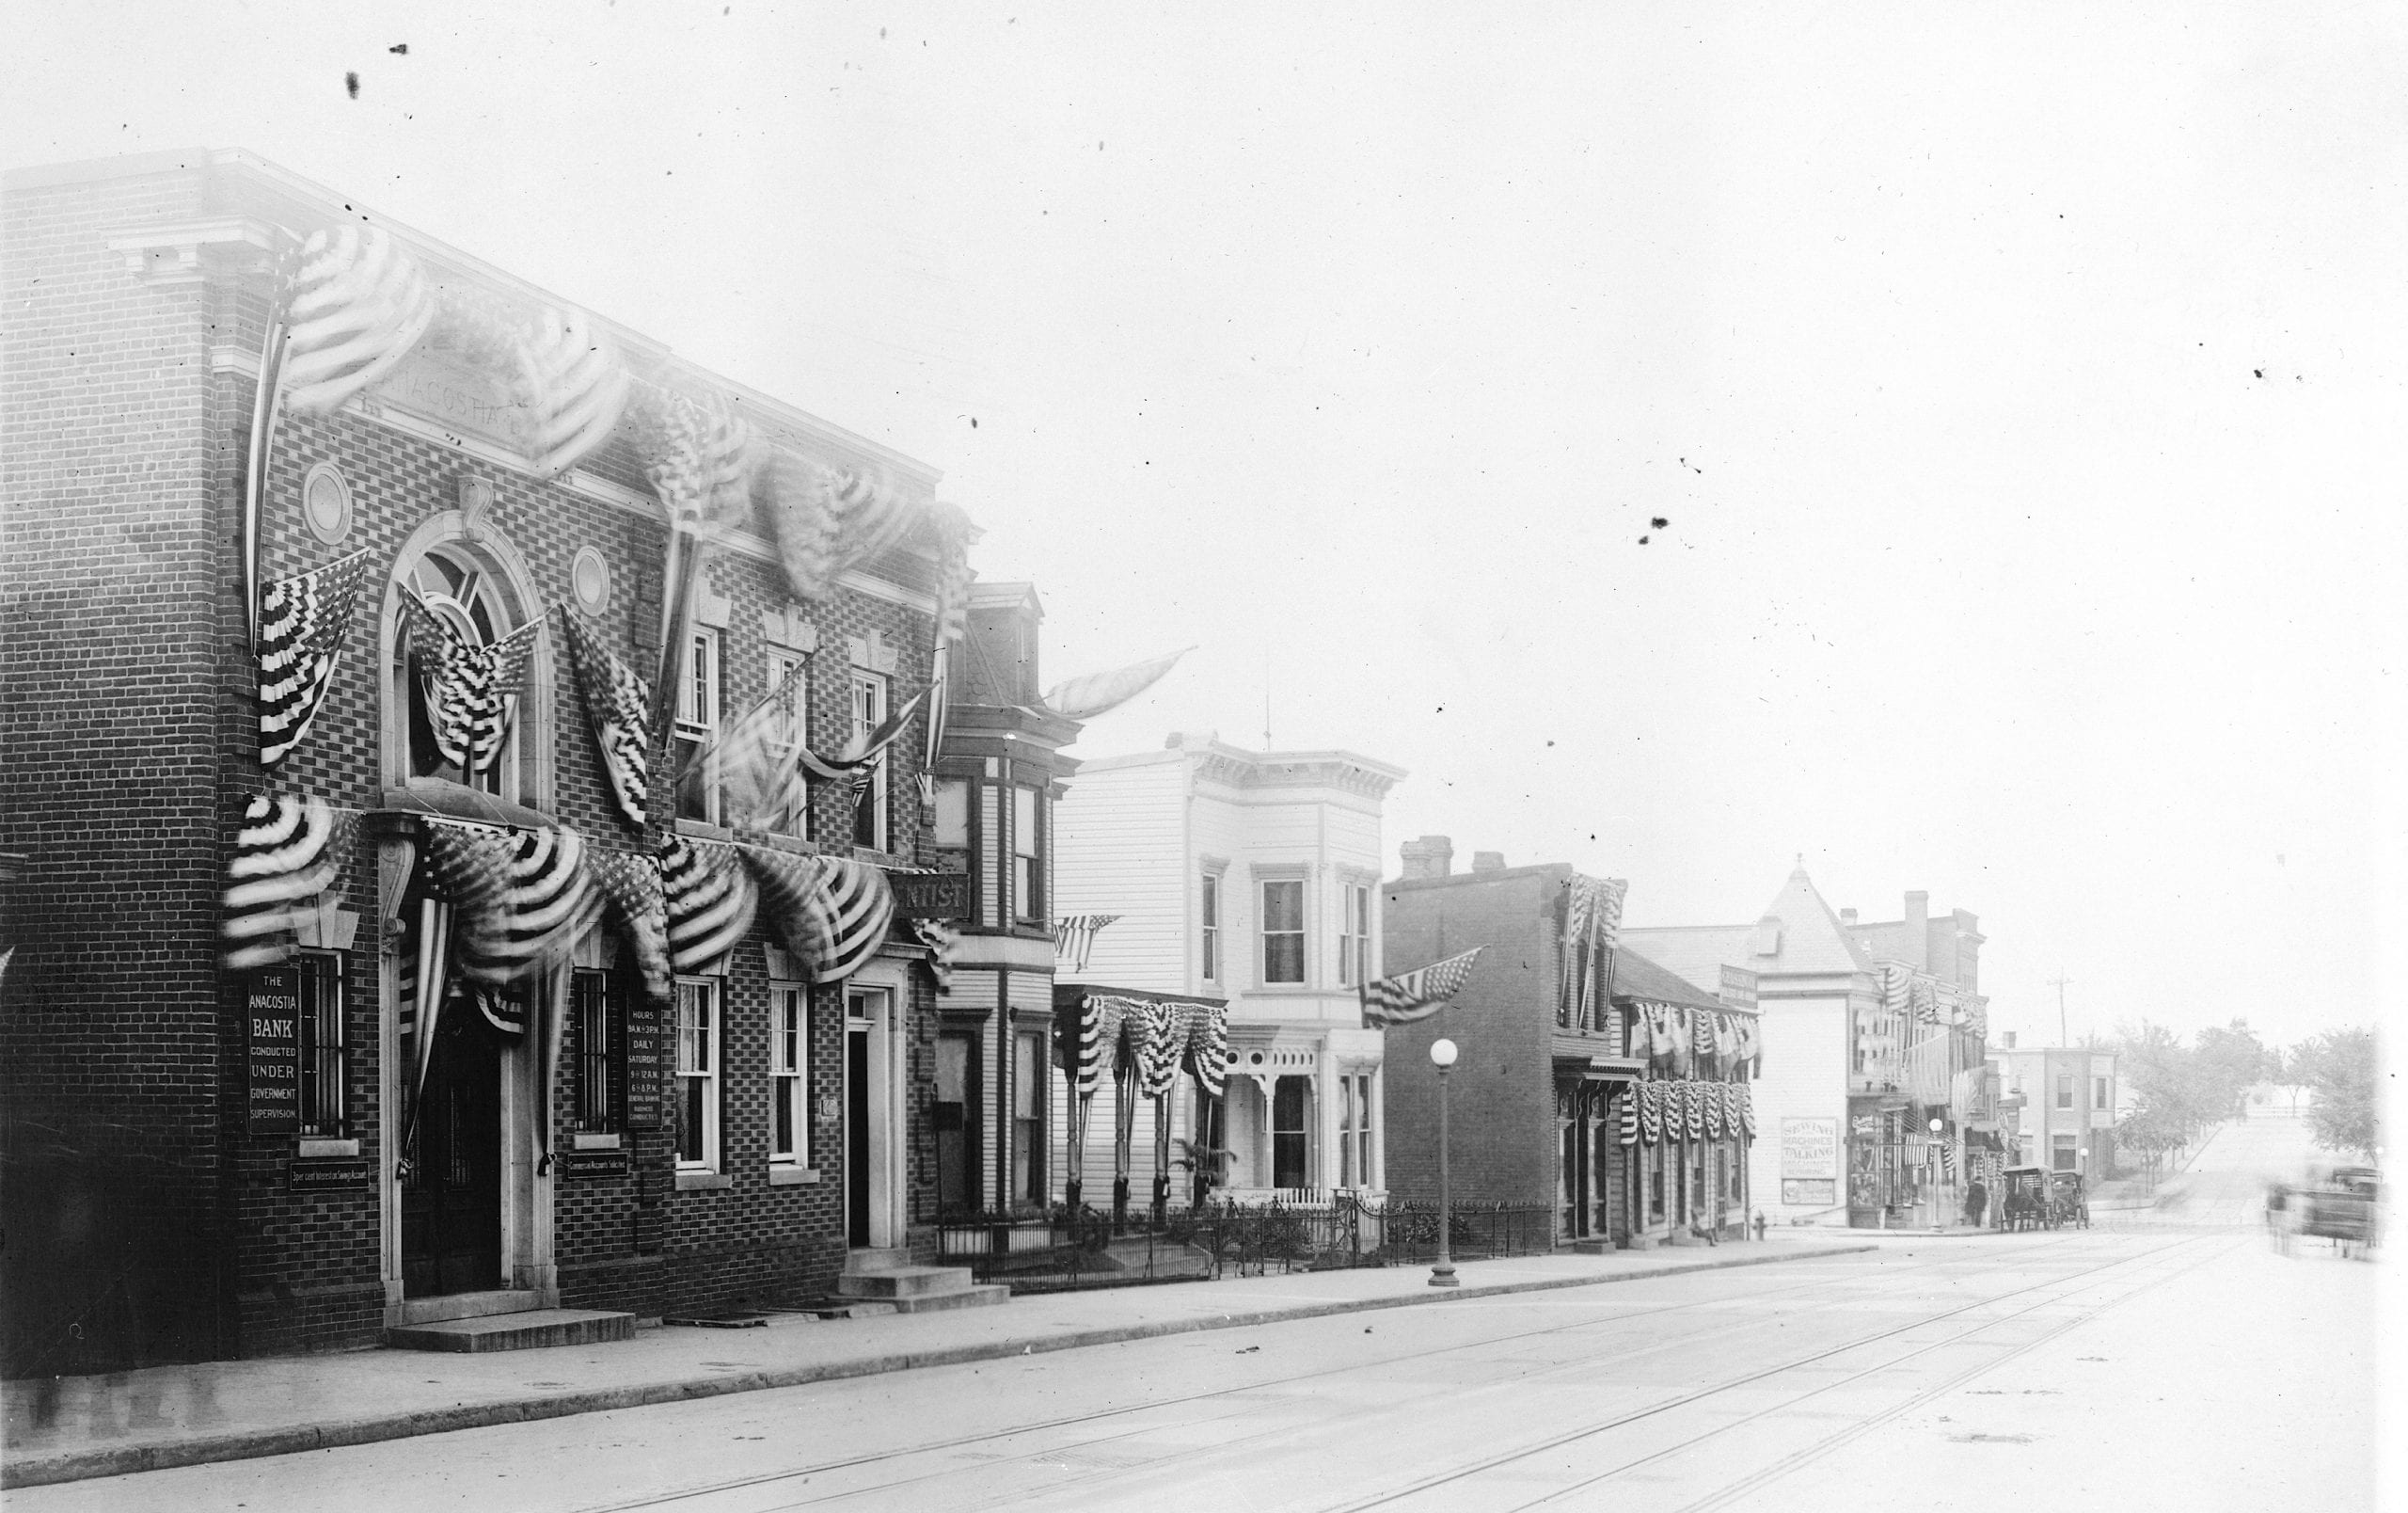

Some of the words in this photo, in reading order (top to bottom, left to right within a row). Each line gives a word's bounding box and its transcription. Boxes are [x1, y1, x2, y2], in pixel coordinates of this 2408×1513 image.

[263, 975, 282, 987] THE
[249, 995, 296, 1010] ANACOSTIA
[632, 1011, 655, 1020] HOURS
[252, 1018, 293, 1039] BANK
[633, 1040, 654, 1049] DAILY
[250, 1046, 296, 1057] CONDUCTED
[627, 1055, 657, 1064] SATURDAY
[251, 1064, 294, 1078] UNDER
[250, 1087, 296, 1100] GOVERNMENT
[1783, 1122, 1833, 1136] SEWING
[1783, 1137, 1832, 1145] MACHINES
[1783, 1146, 1833, 1159] TALKING
